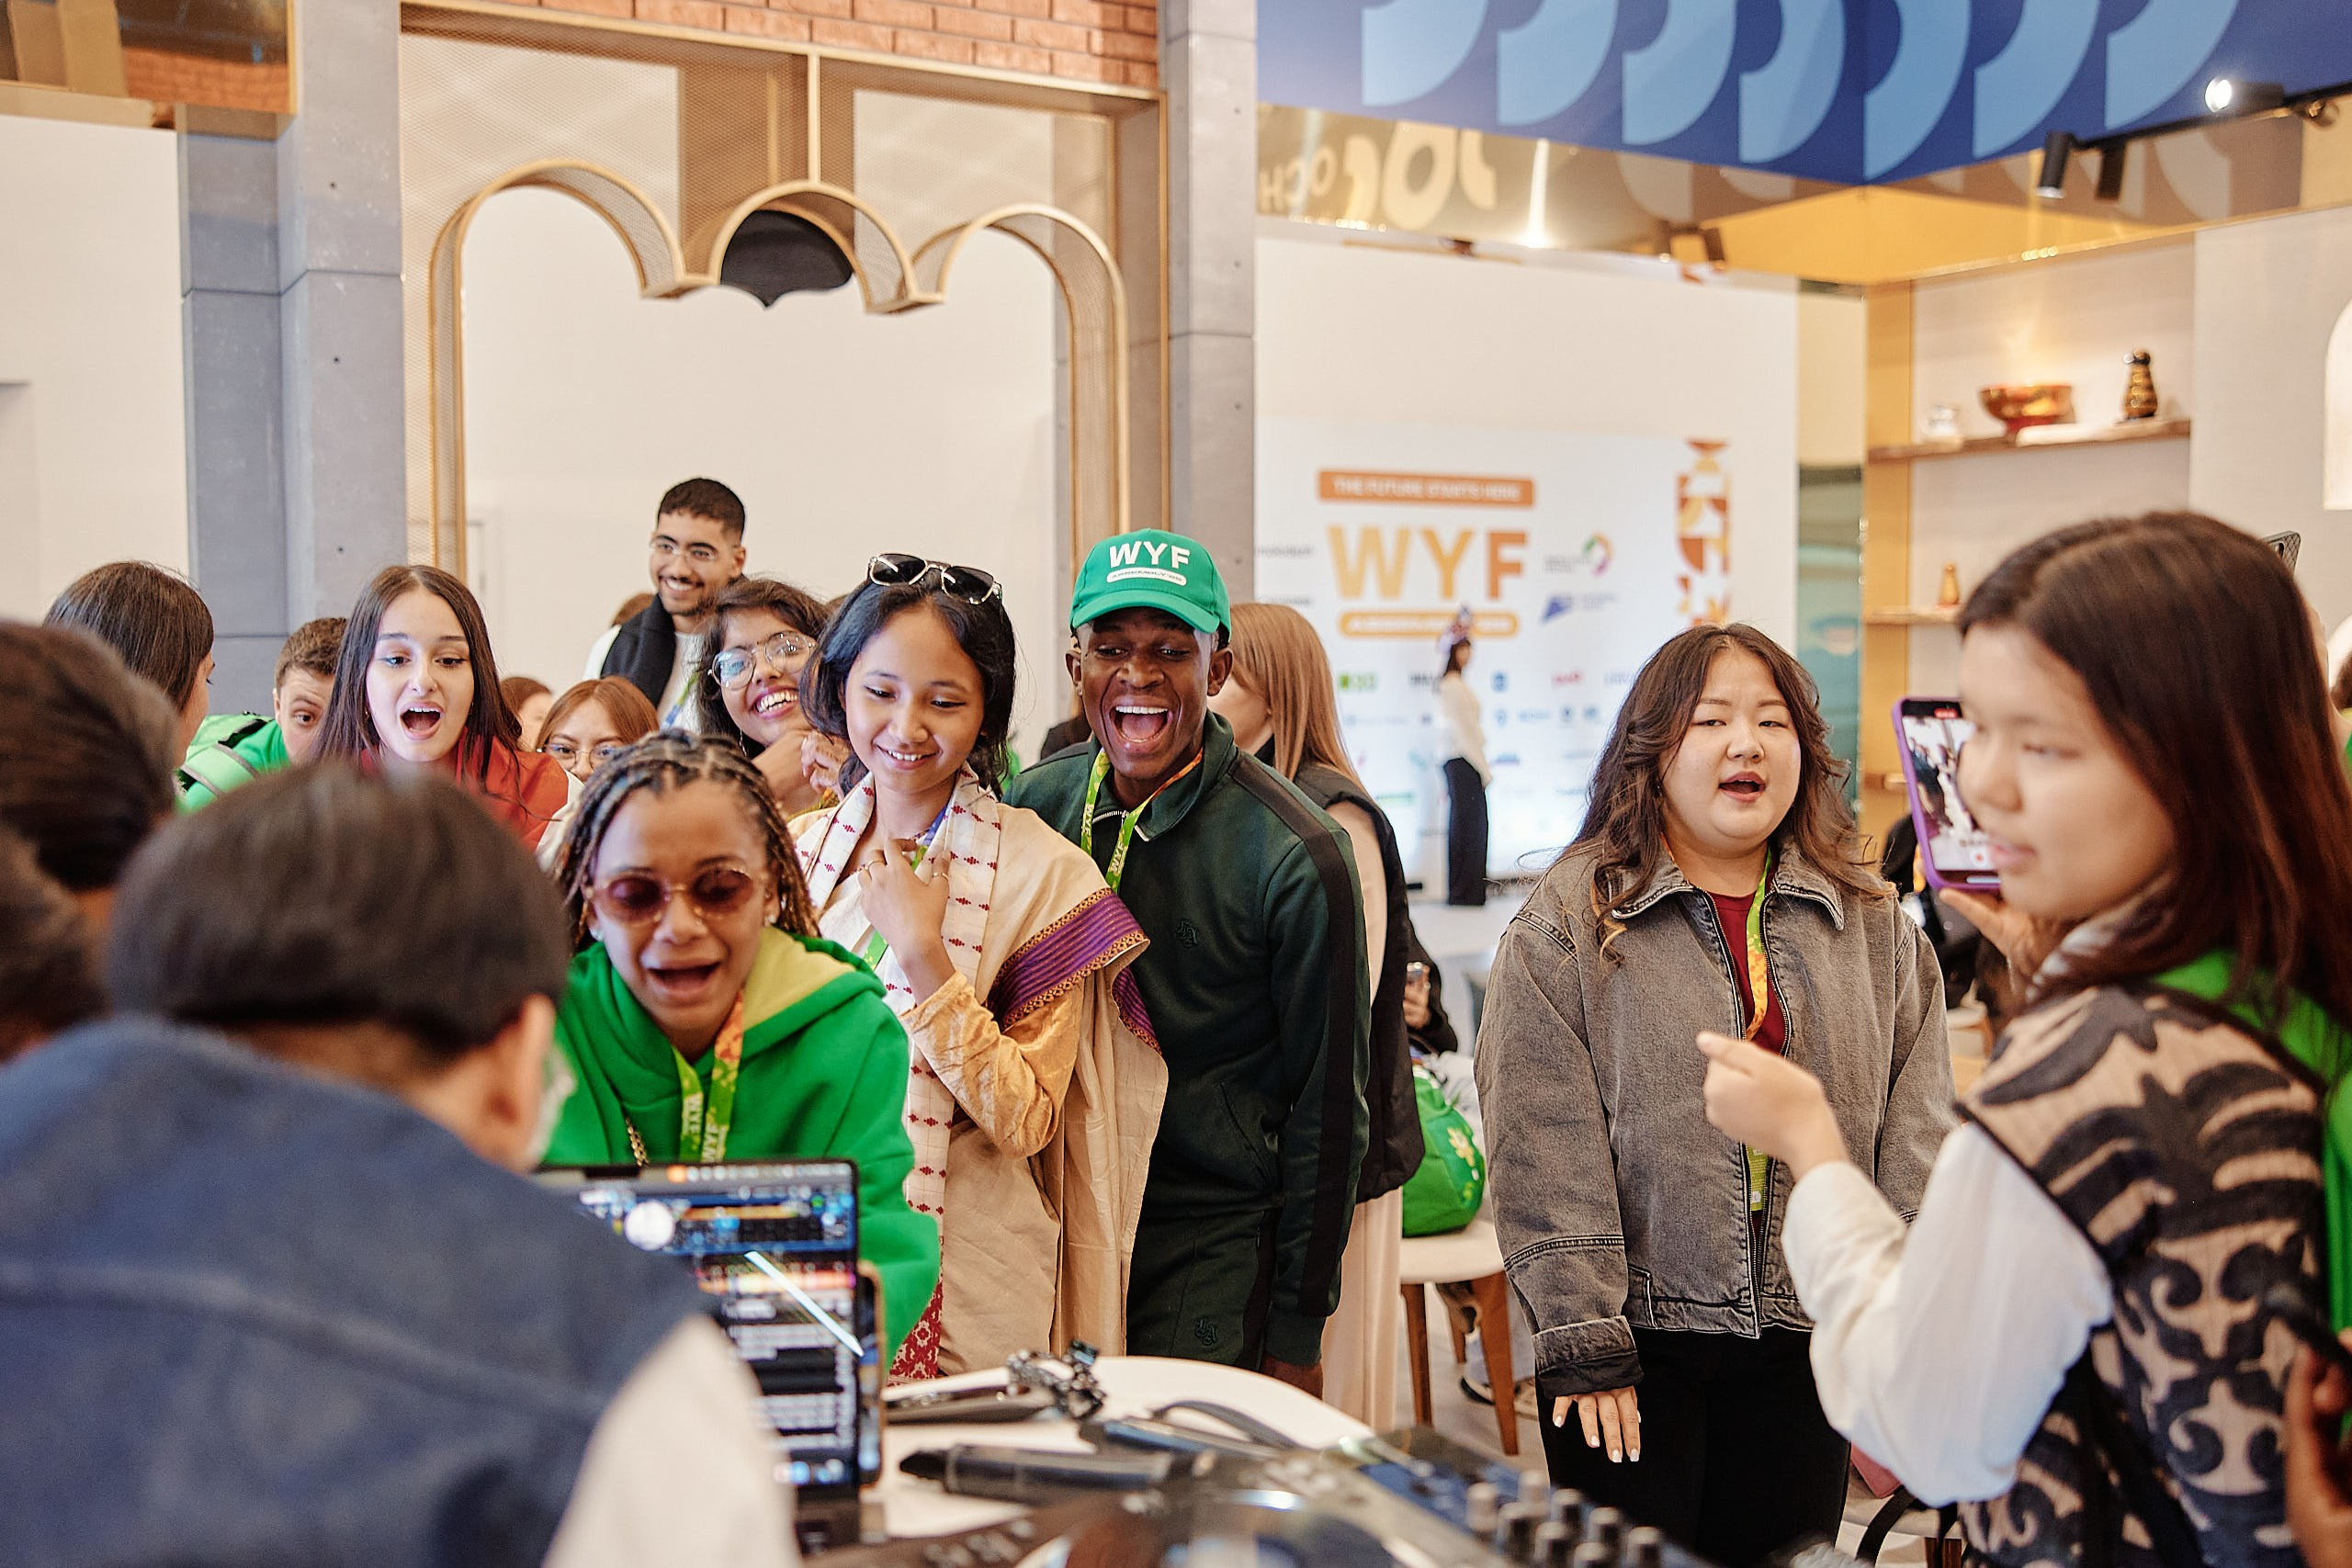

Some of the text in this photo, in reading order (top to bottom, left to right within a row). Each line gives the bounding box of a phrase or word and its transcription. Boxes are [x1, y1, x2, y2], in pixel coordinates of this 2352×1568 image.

[1333, 477, 1363, 496] THE
[1367, 479, 1422, 498] FUTURE
[1109, 541, 1191, 569] WYF
[1326, 524, 1528, 602] WYF
